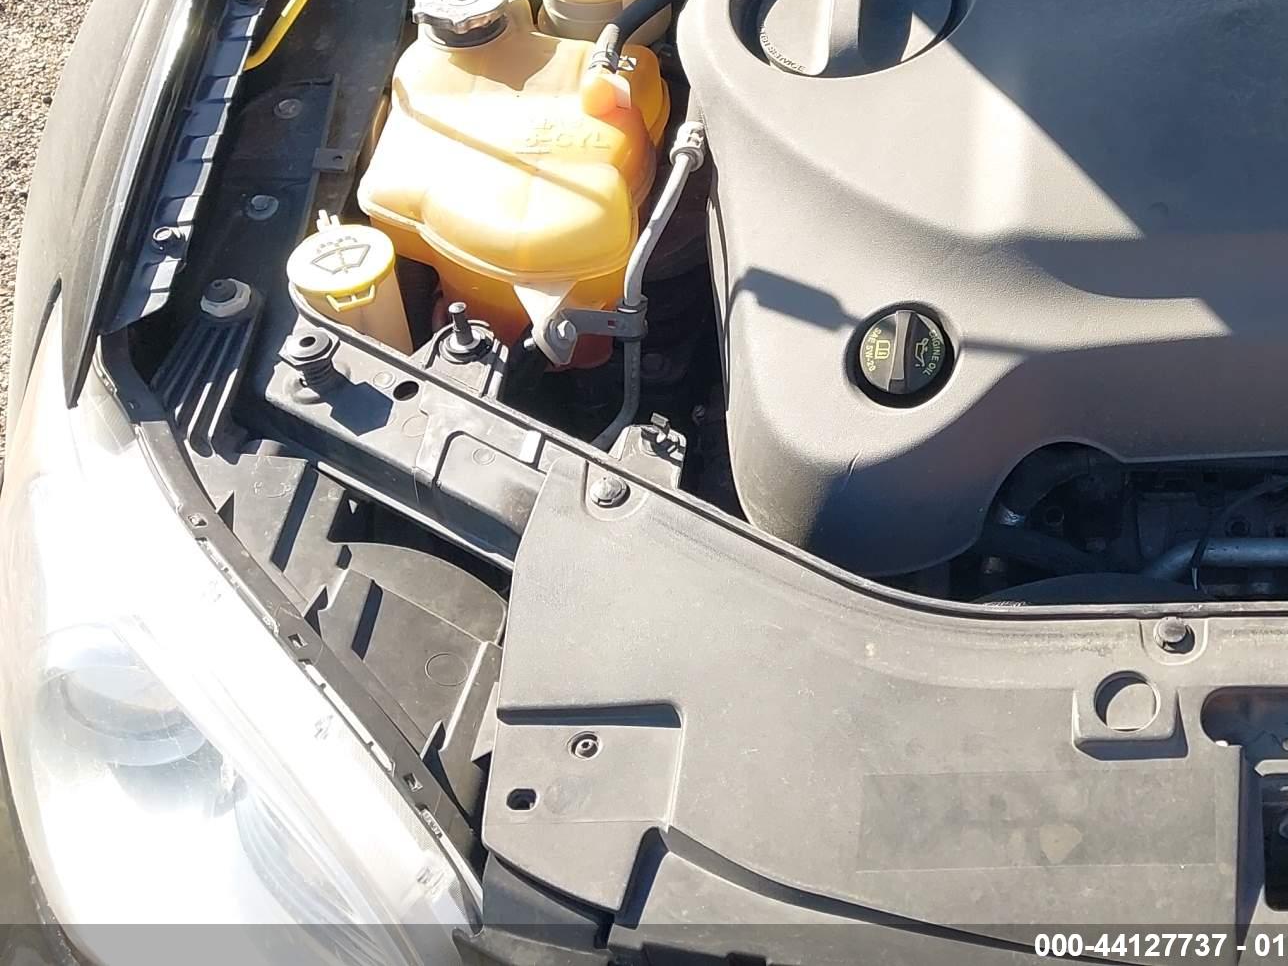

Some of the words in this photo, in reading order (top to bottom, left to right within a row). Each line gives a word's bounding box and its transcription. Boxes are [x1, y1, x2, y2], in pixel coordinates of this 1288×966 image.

[867, 327, 882, 344] SAE
[929, 329, 942, 362] ENGINE
[922, 362, 937, 376] OIL
